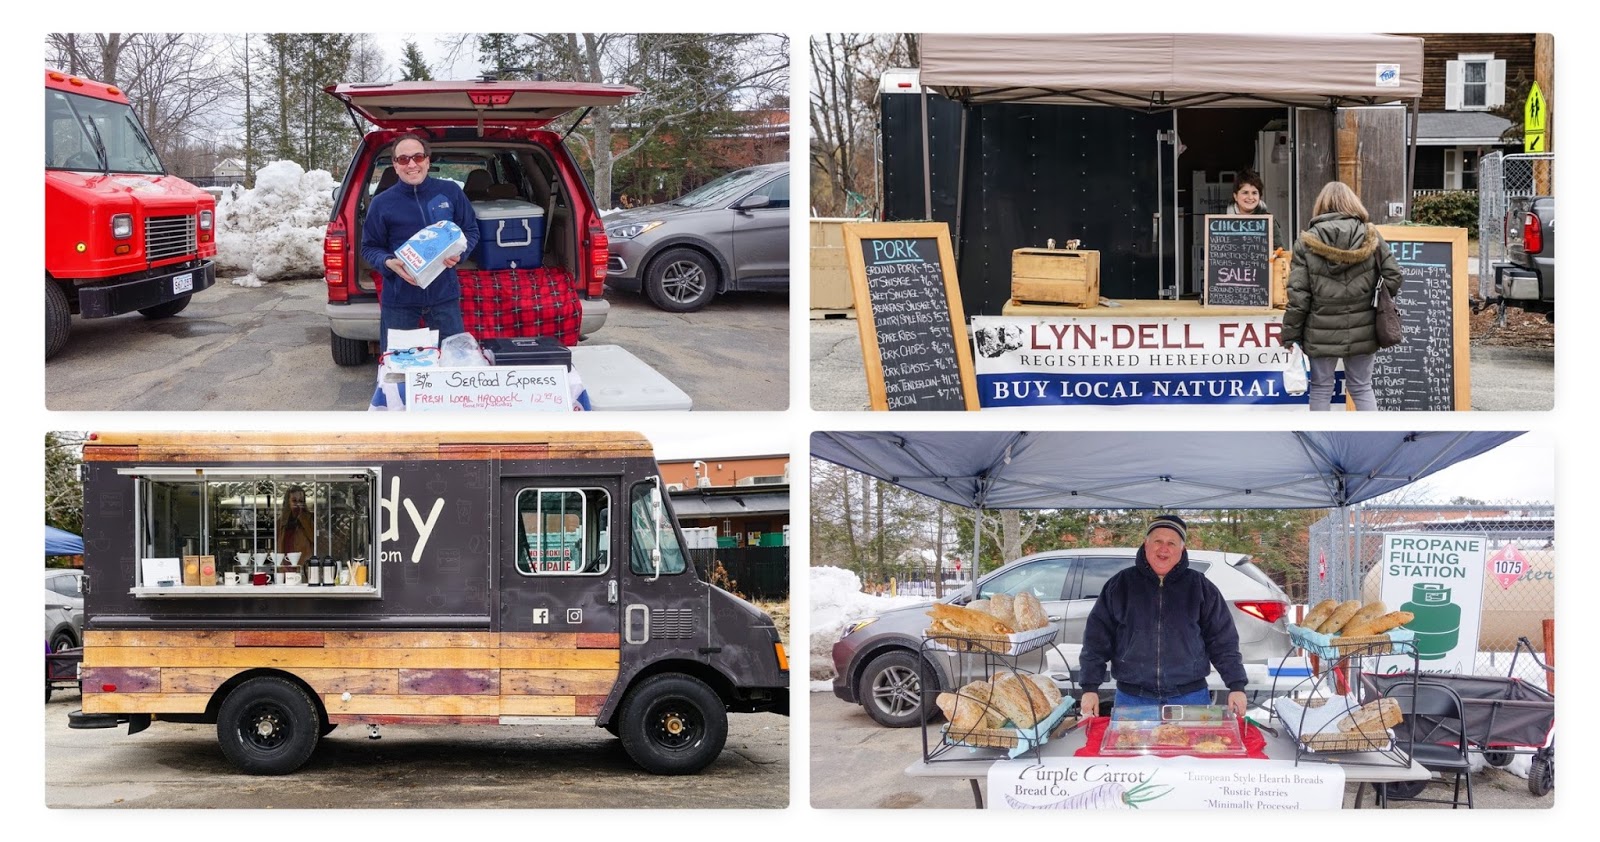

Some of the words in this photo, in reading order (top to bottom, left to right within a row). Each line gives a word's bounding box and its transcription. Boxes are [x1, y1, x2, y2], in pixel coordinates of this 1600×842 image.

[1210, 220, 1266, 231] CHICKEN
[872, 240, 919, 260] PORK
[1386, 242, 1424, 260] EEF
[865, 264, 895, 275] GROUND
[897, 263, 919, 274] PORK
[1217, 268, 1256, 282] SALE!
[1030, 323, 1204, 350] LYN-DELL
[1219, 321, 1284, 348] FAR
[879, 347, 900, 360] PORK
[900, 343, 927, 357] CHOPS
[1020, 353, 1140, 367] REGISTERED
[1149, 352, 1250, 366] HEREFORD
[1258, 352, 1290, 364] CAT
[882, 365, 900, 377] PORK
[900, 362, 930, 374] ROASTS
[884, 381, 901, 393] PORK
[899, 376, 937, 391] TENDERLOIN
[993, 380, 1051, 400] BUY
[1060, 381, 1143, 398] LOCAL
[1152, 379, 1280, 397] NATURAL
[414, 393, 444, 404] FRESH
[449, 394, 474, 403] LOCAL
[887, 394, 917, 409] BACON
[381, 476, 445, 563] dy
[1391, 538, 1479, 552] PROPANE
[381, 550, 402, 562] om
[1390, 551, 1459, 565] FILLING
[1389, 565, 1466, 578] STATION
[1496, 561, 1521, 573] 1075
[1018, 764, 1078, 785] Purple
[1083, 763, 1145, 783] Carrot
[1233, 773, 1255, 785] Style
[1259, 773, 1290, 784] Hearth
[1293, 775, 1324, 784] Breads
[1015, 785, 1047, 796] Bread
[1050, 785, 1070, 796] Co.
[1254, 787, 1288, 796] Pastries
